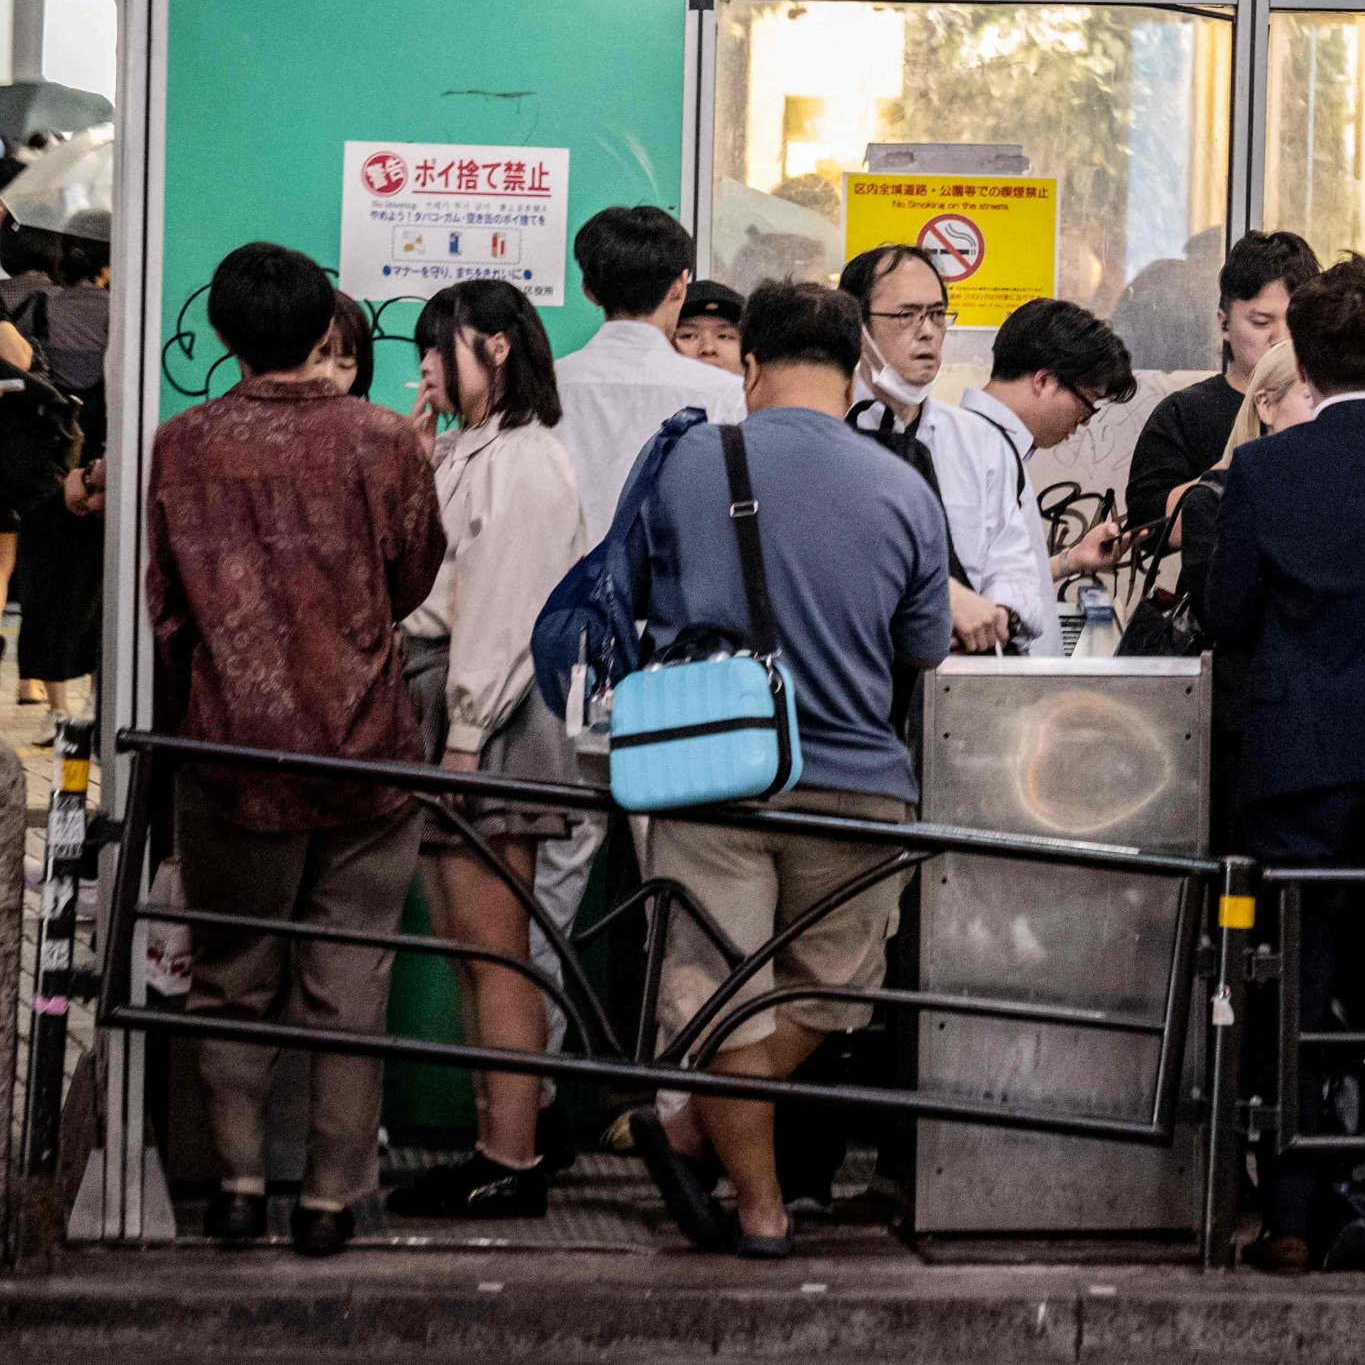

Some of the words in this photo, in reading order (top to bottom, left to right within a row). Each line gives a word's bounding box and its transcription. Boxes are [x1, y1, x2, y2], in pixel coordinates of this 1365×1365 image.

[414, 159, 551, 192] ポイ捨て禁止
